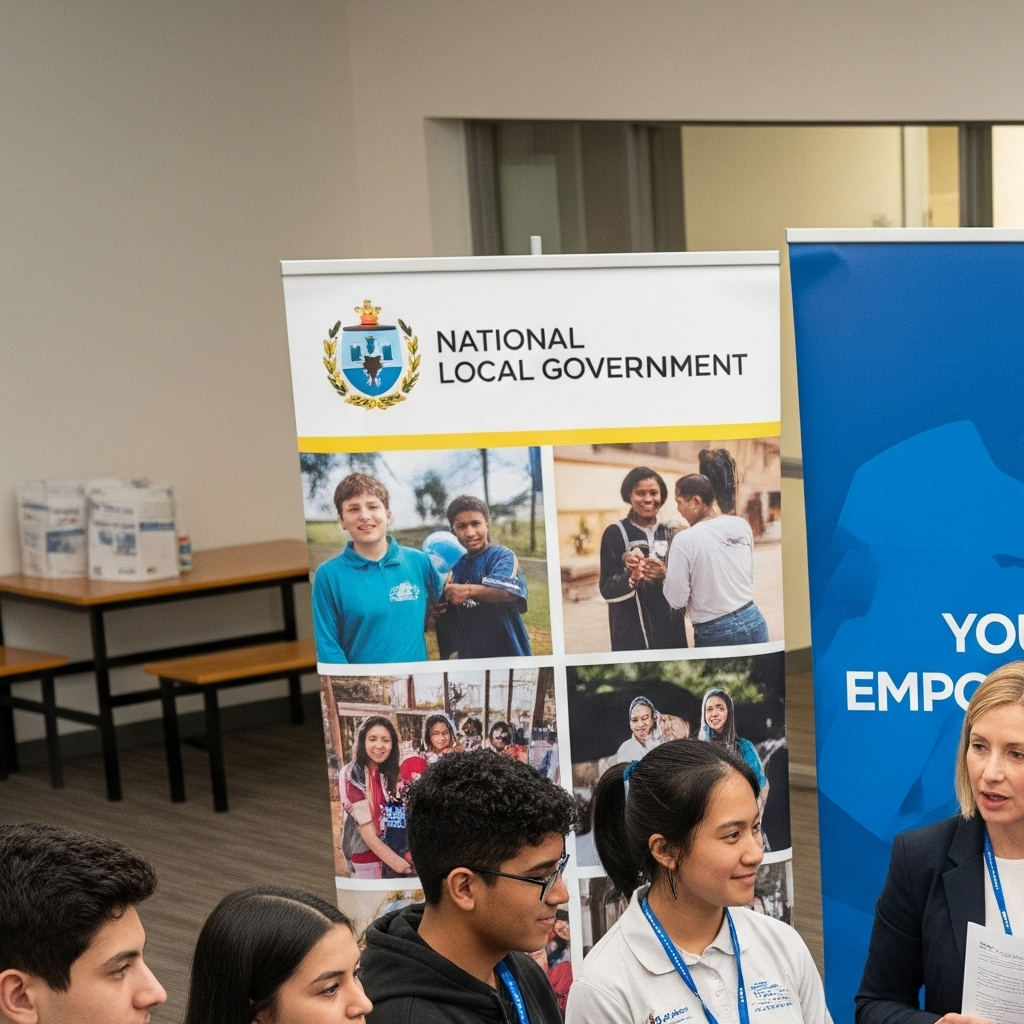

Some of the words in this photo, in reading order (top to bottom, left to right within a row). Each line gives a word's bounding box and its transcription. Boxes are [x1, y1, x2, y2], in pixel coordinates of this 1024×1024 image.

[436, 328, 585, 353] NATIONAL
[438, 359, 535, 383] LOCAL
[542, 354, 748, 380] GOVERNMENT
